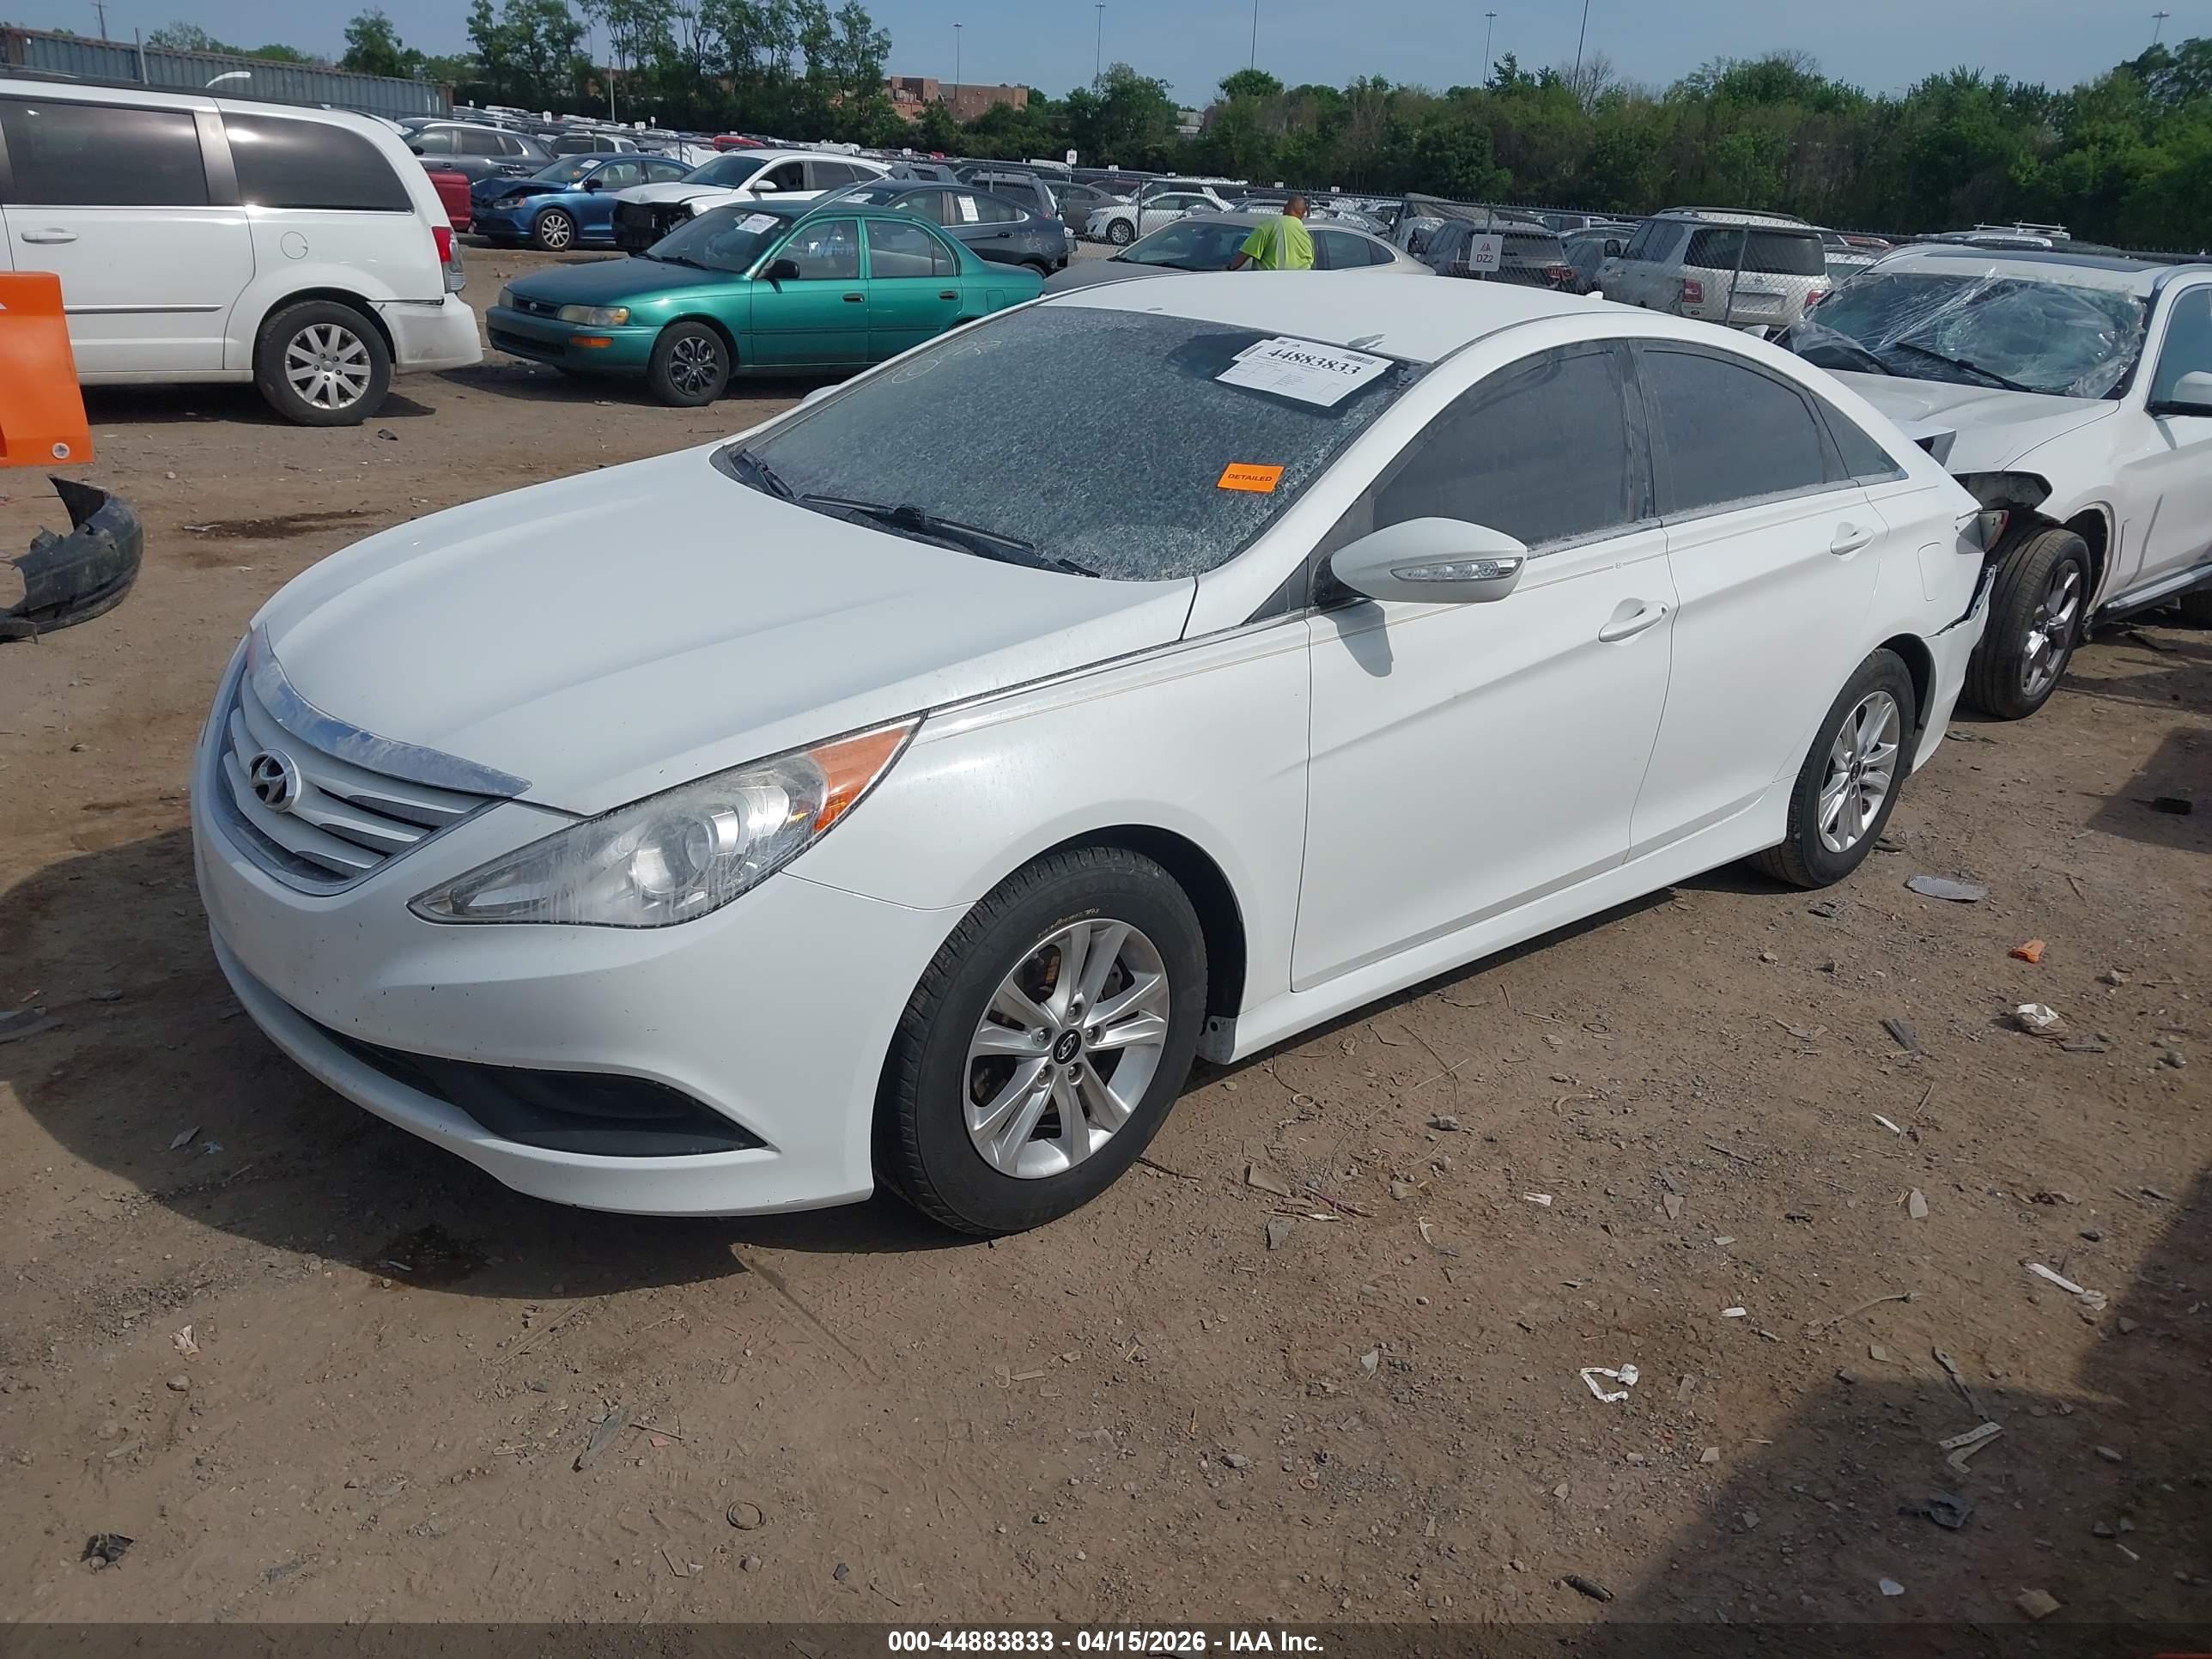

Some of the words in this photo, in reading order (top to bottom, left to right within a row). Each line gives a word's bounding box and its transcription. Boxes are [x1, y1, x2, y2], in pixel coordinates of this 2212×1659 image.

[1477, 254, 1493, 263] DZ2
[1267, 349, 1361, 375] 44883833
[1228, 473, 1273, 482] DETAILED
